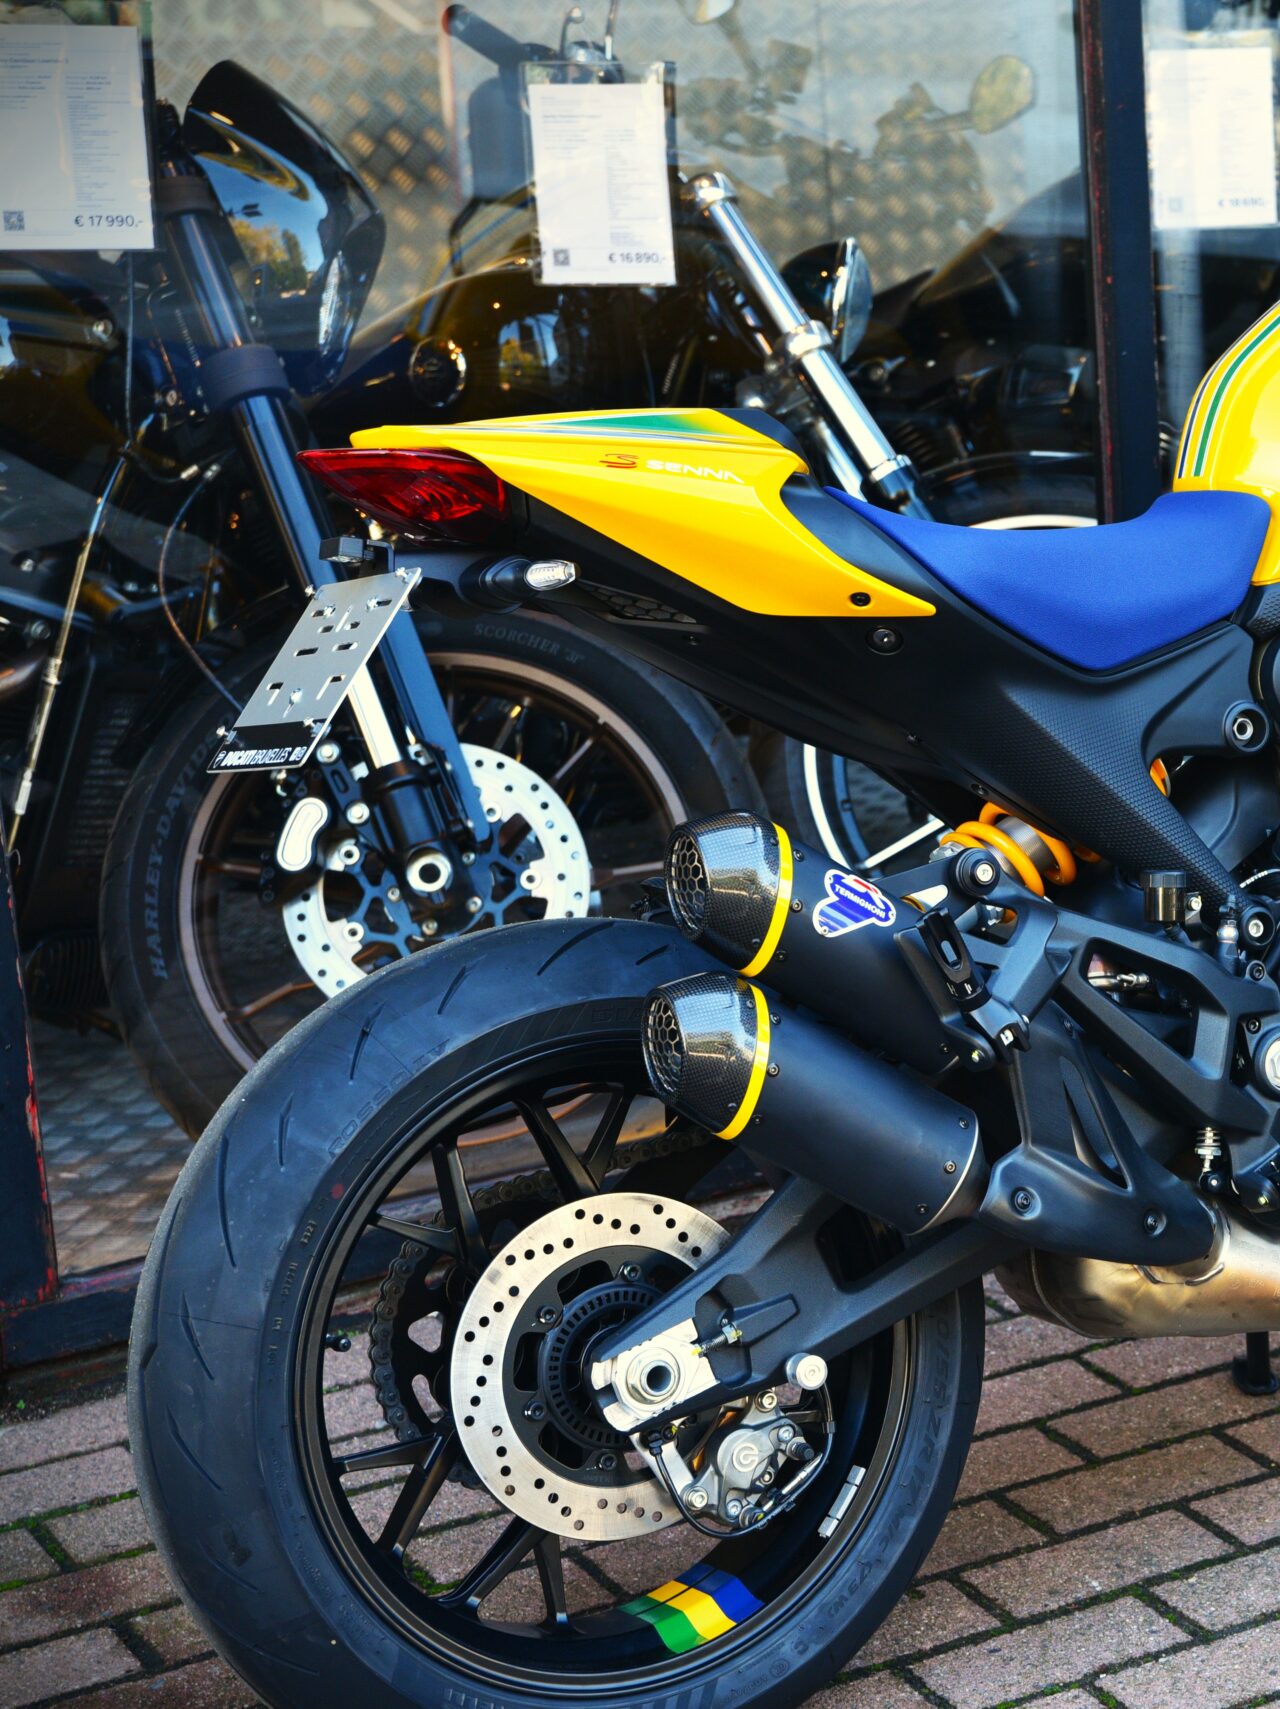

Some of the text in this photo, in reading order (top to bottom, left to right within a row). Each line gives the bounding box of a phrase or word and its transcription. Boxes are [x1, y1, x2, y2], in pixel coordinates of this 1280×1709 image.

[74, 215, 84, 227] €
[608, 252, 616, 263] €
[645, 459, 745, 484] SENNA
[474, 623, 561, 656] SCORCHER
[834, 883, 886, 919] TERMIGNONI
